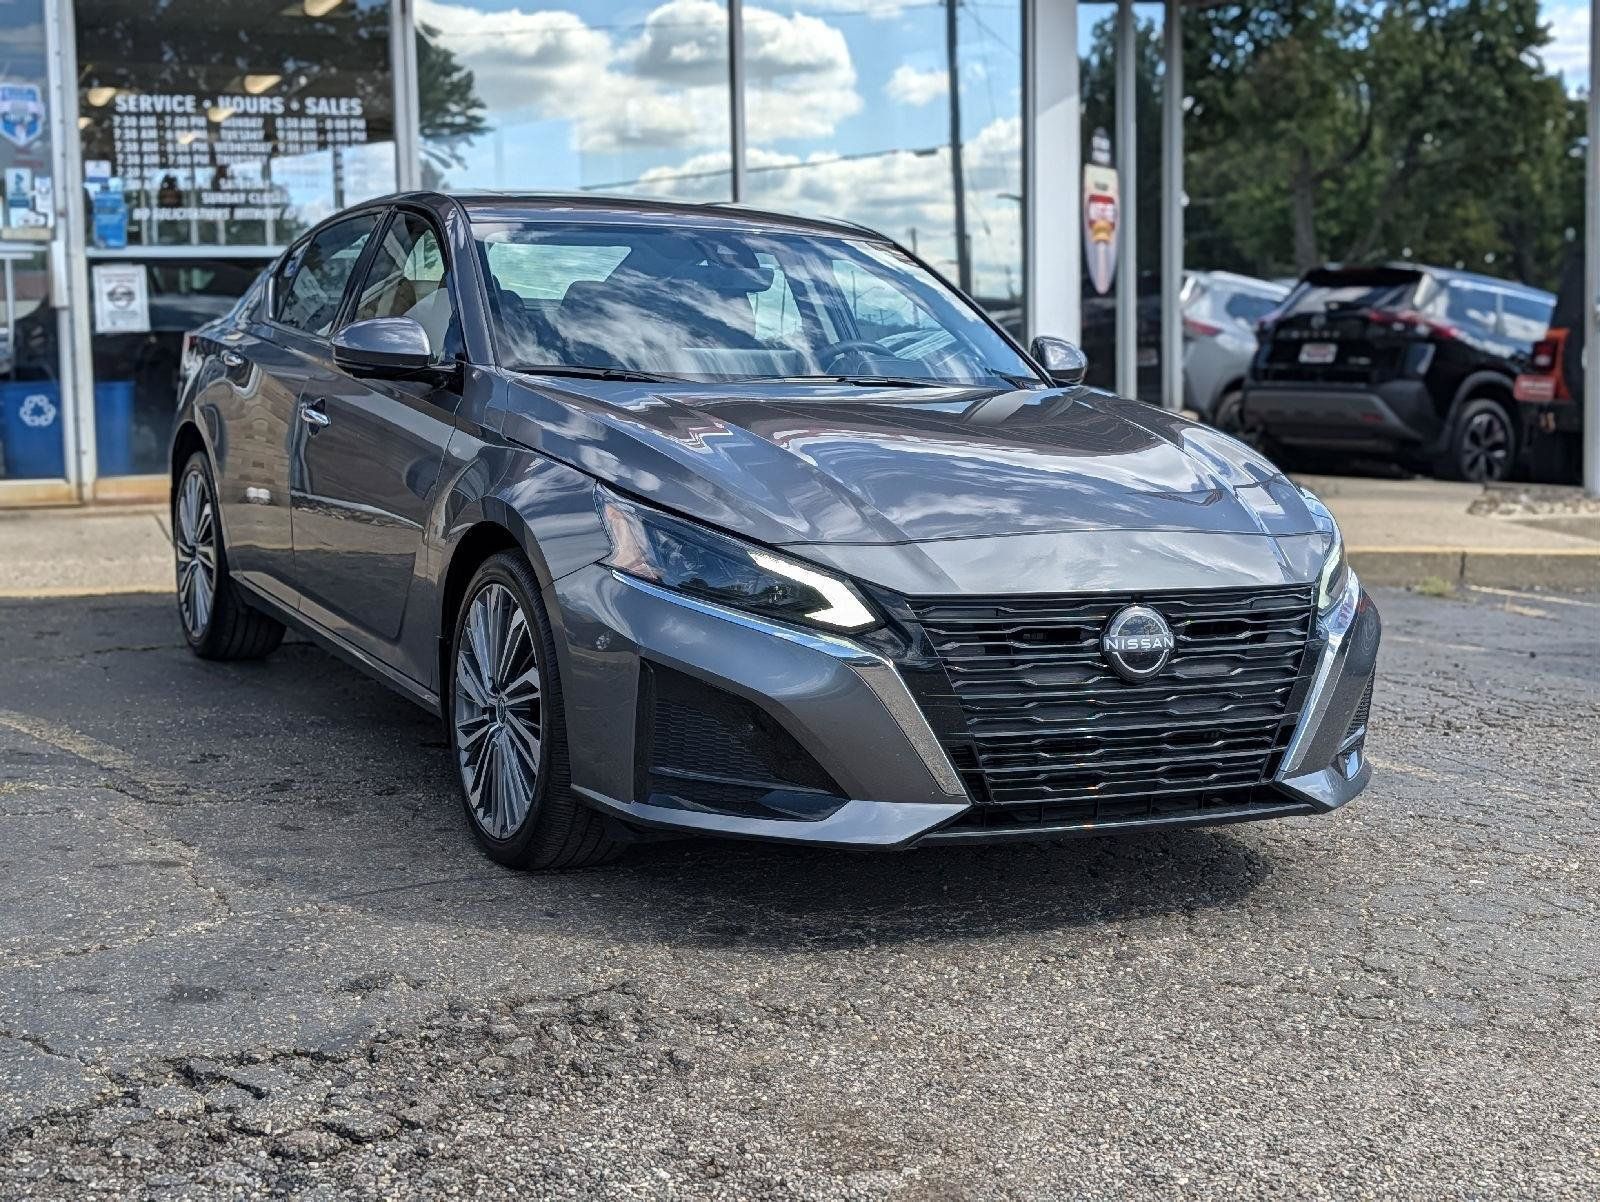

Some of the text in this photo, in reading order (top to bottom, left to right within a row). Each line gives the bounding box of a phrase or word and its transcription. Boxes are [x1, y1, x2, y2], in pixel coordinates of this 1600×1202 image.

[115, 94, 363, 116] SERVICE HOURS SALES
[1106, 636, 1174, 650] NISSAN
